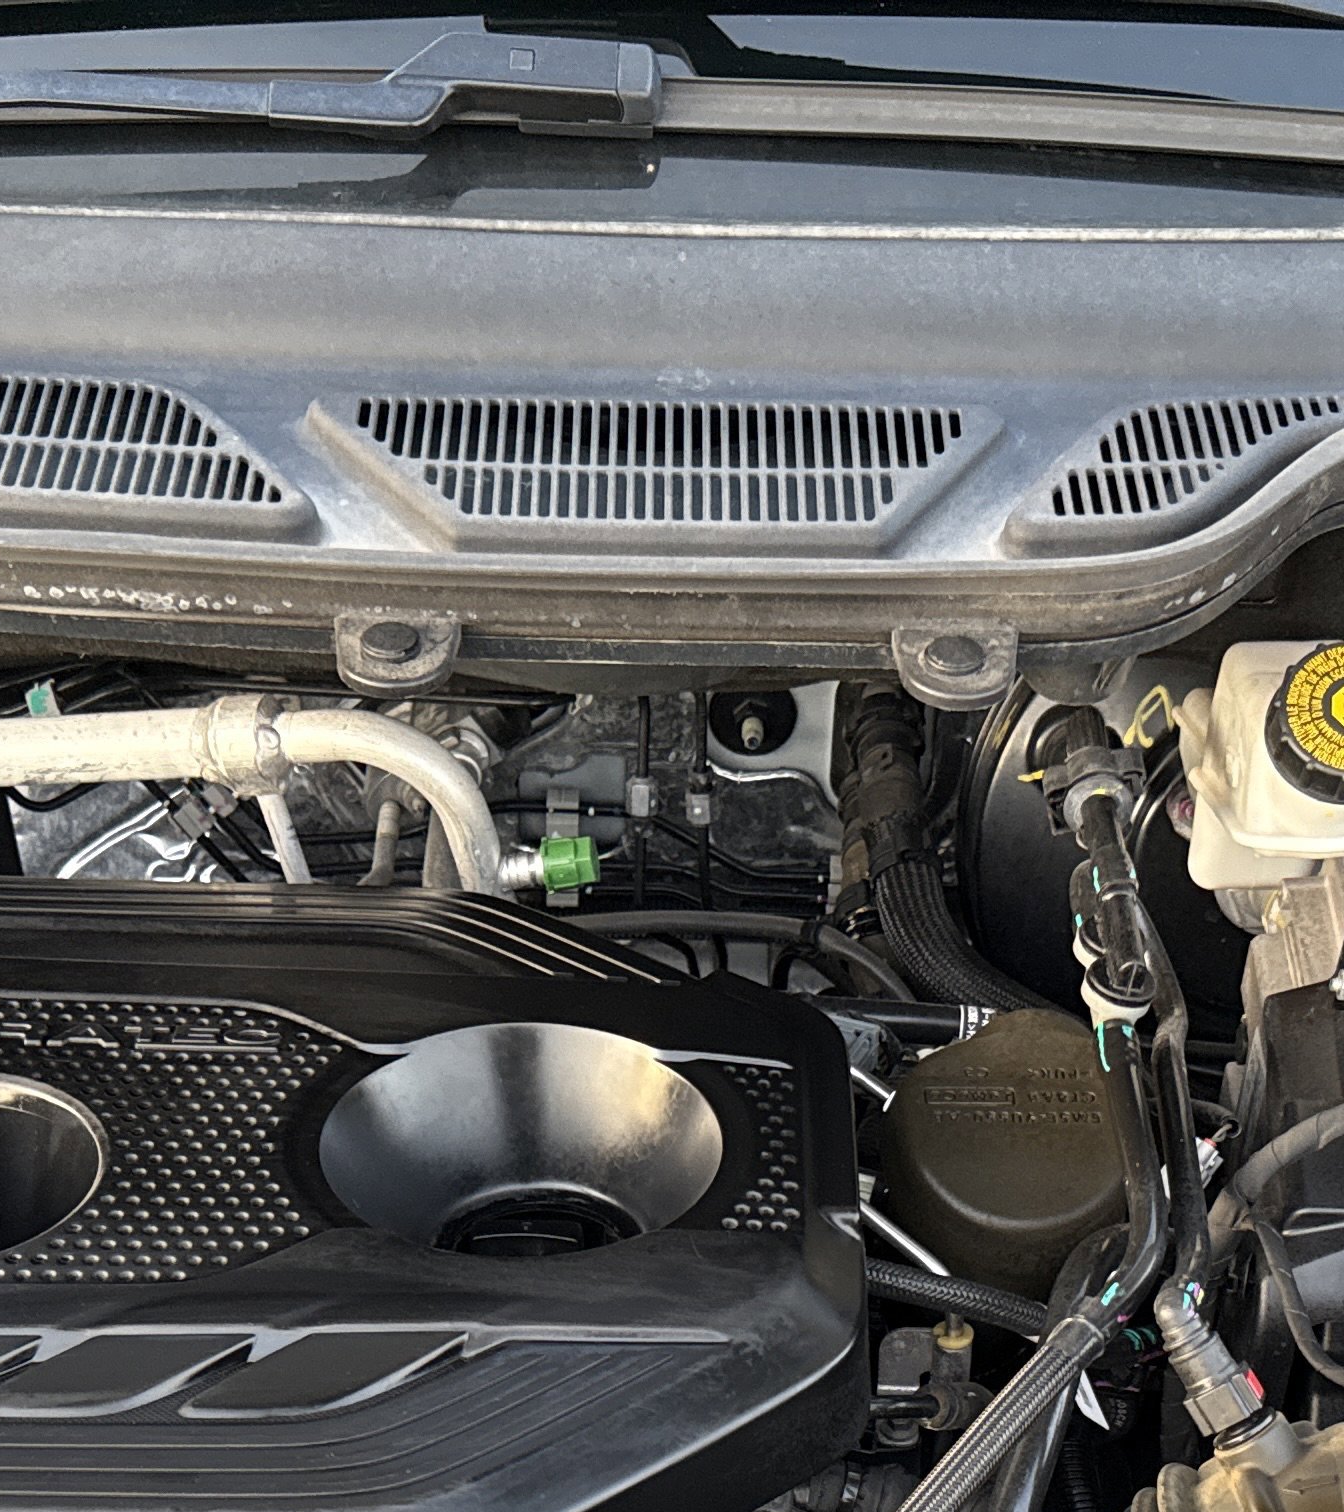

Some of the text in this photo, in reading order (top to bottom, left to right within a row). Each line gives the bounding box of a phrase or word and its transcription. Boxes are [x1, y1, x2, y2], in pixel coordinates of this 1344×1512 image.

[1302, 651, 1328, 673] AVANT
[1314, 657, 1337, 677] FREIN
[1285, 668, 1310, 704] BOUCHON
[1306, 671, 1320, 685] DE
[1297, 681, 1314, 710] LIQUIDE
[1286, 705, 1298, 715] LE
[1298, 711, 1311, 723] DU
[1287, 715, 1317, 754] NETTOYER
[1302, 721, 1319, 739] QUE
